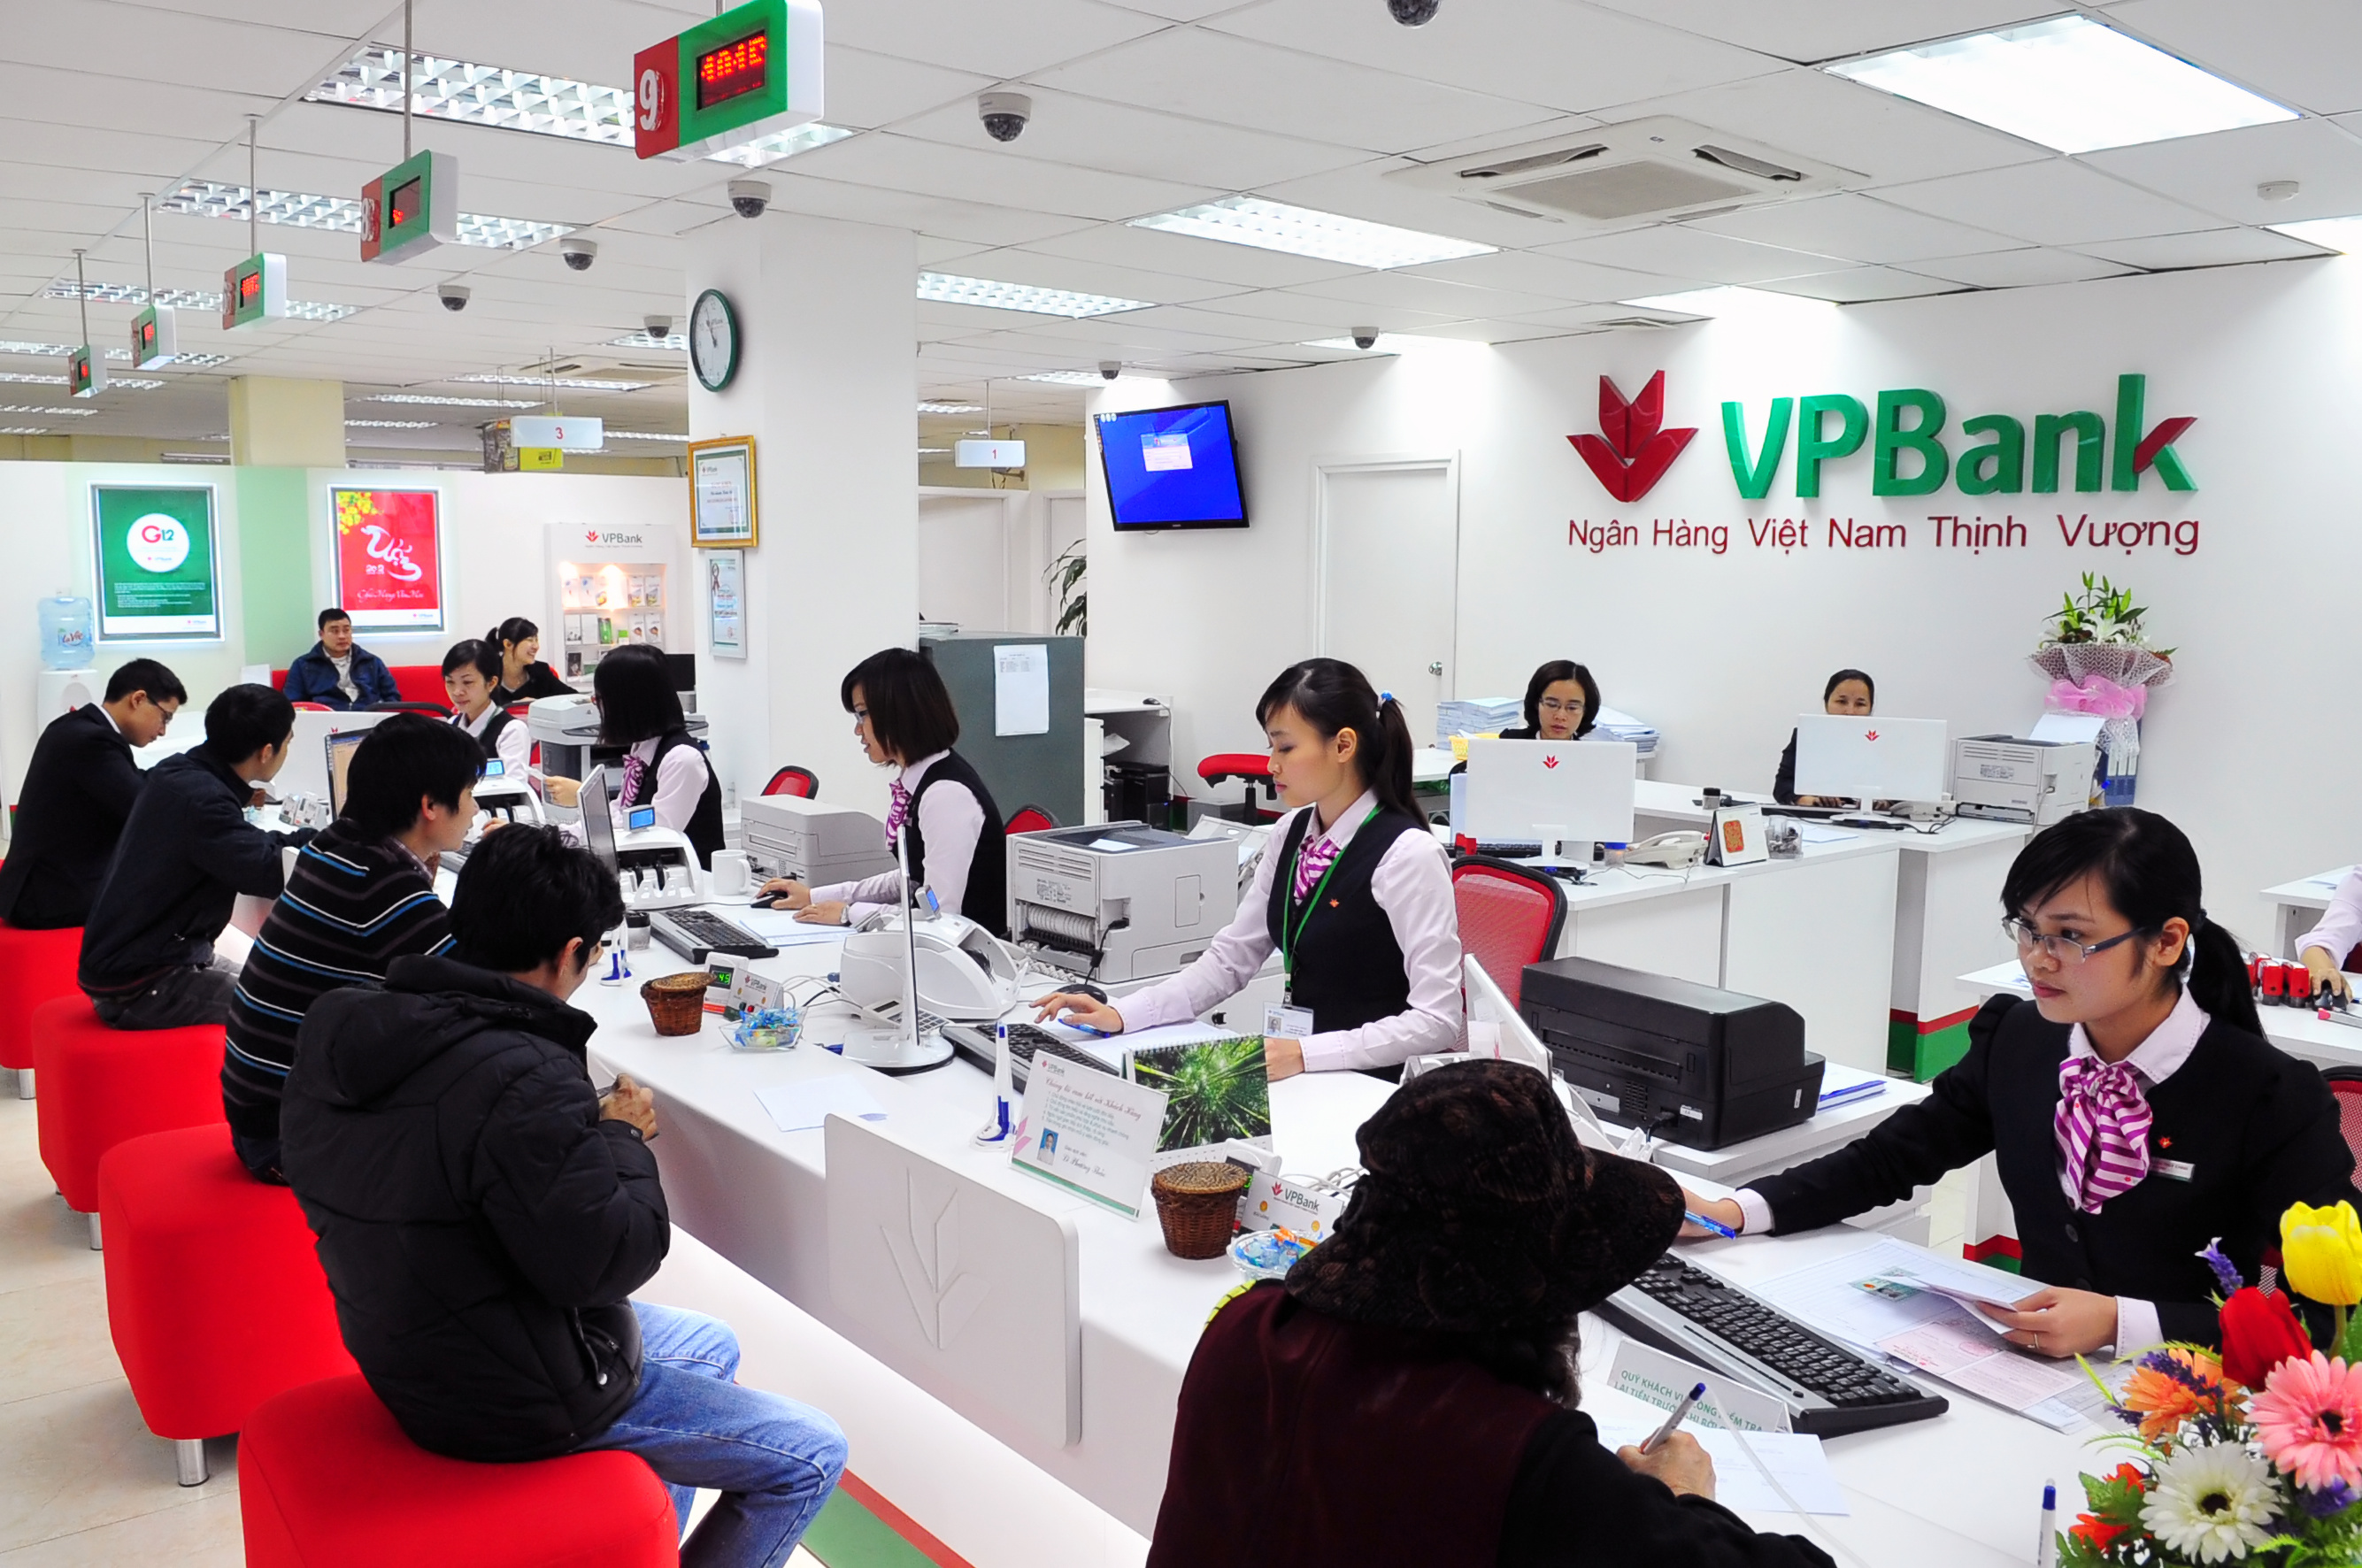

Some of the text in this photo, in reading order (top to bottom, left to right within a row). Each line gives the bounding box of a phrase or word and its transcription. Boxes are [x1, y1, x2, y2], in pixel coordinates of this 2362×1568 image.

[639, 68, 658, 131] 9
[555, 427, 564, 440] 3
[1720, 373, 2199, 500] VPBank
[992, 449, 998, 460] 1
[142, 525, 174, 543] G12
[602, 533, 643, 543] VPBank
[1568, 514, 2200, 555] Ngân Hàng Việt Nam Thịnh Vượng
[1284, 1188, 1319, 1211] VPBank
[1642, 1378, 1673, 1398] KHÁCH
